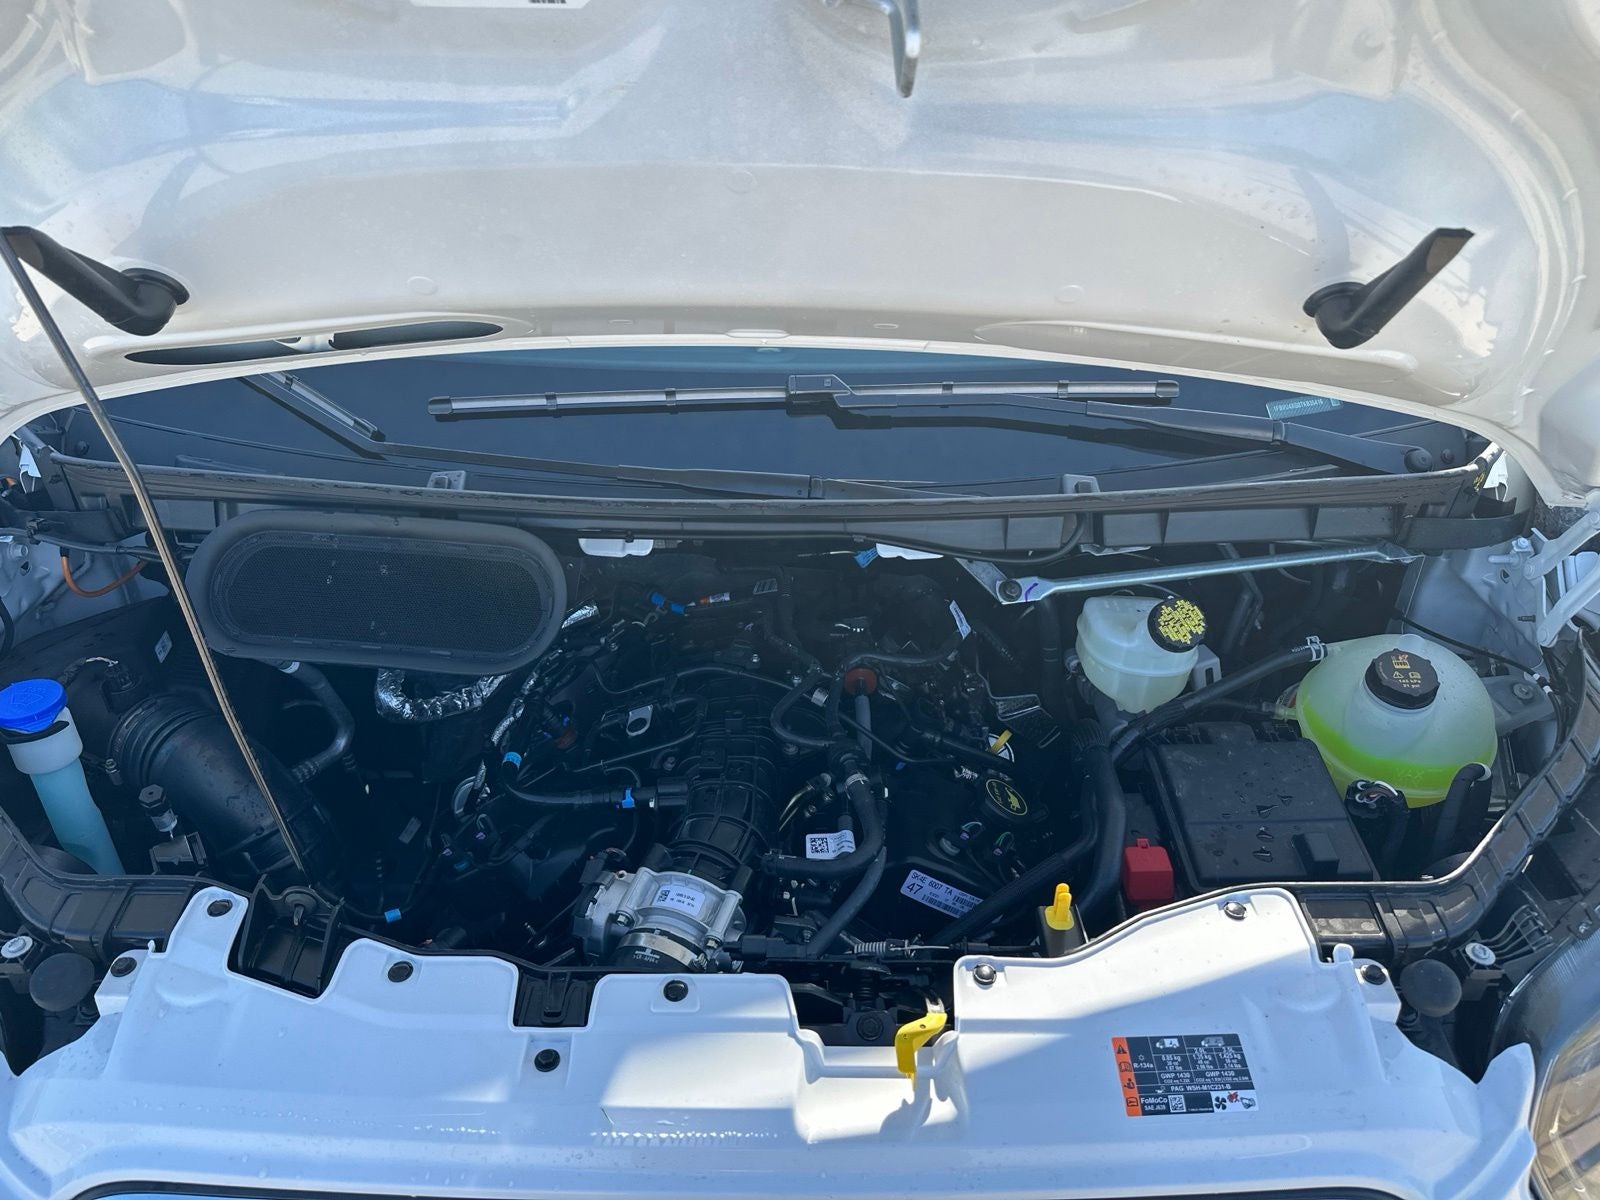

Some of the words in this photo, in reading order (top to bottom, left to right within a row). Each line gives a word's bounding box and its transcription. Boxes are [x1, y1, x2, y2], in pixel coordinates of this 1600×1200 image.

[906, 882, 923, 895] 47
[944, 886, 953, 896] TA
[1140, 1096, 1168, 1104] FoMoCo
